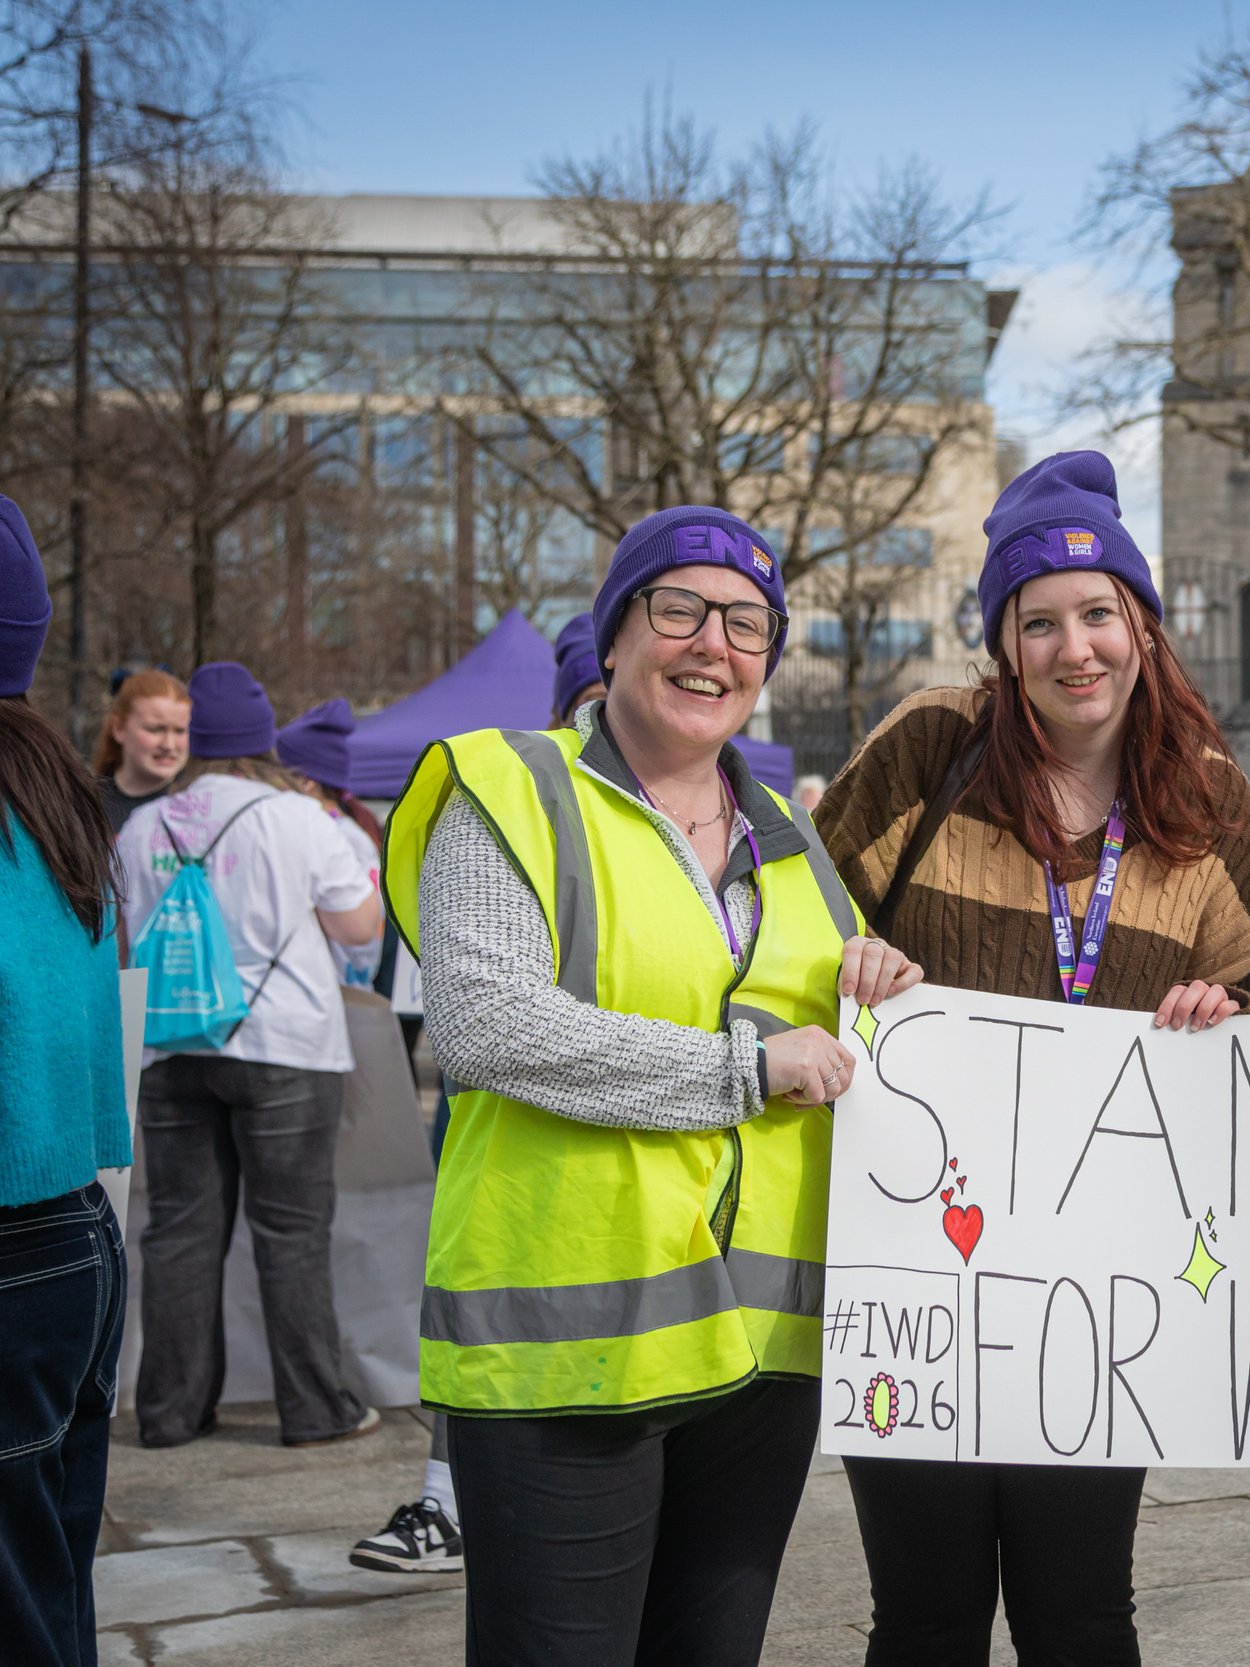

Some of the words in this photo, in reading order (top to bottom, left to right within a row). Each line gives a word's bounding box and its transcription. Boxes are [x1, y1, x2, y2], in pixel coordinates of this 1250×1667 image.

[1000, 527, 1103, 591] END
[1096, 856, 1118, 896] END
[1054, 916, 1073, 957] END
[823, 1298, 955, 1364] #IWD
[974, 1270, 1165, 1460] FOR
[833, 1372, 956, 1439] 2026
